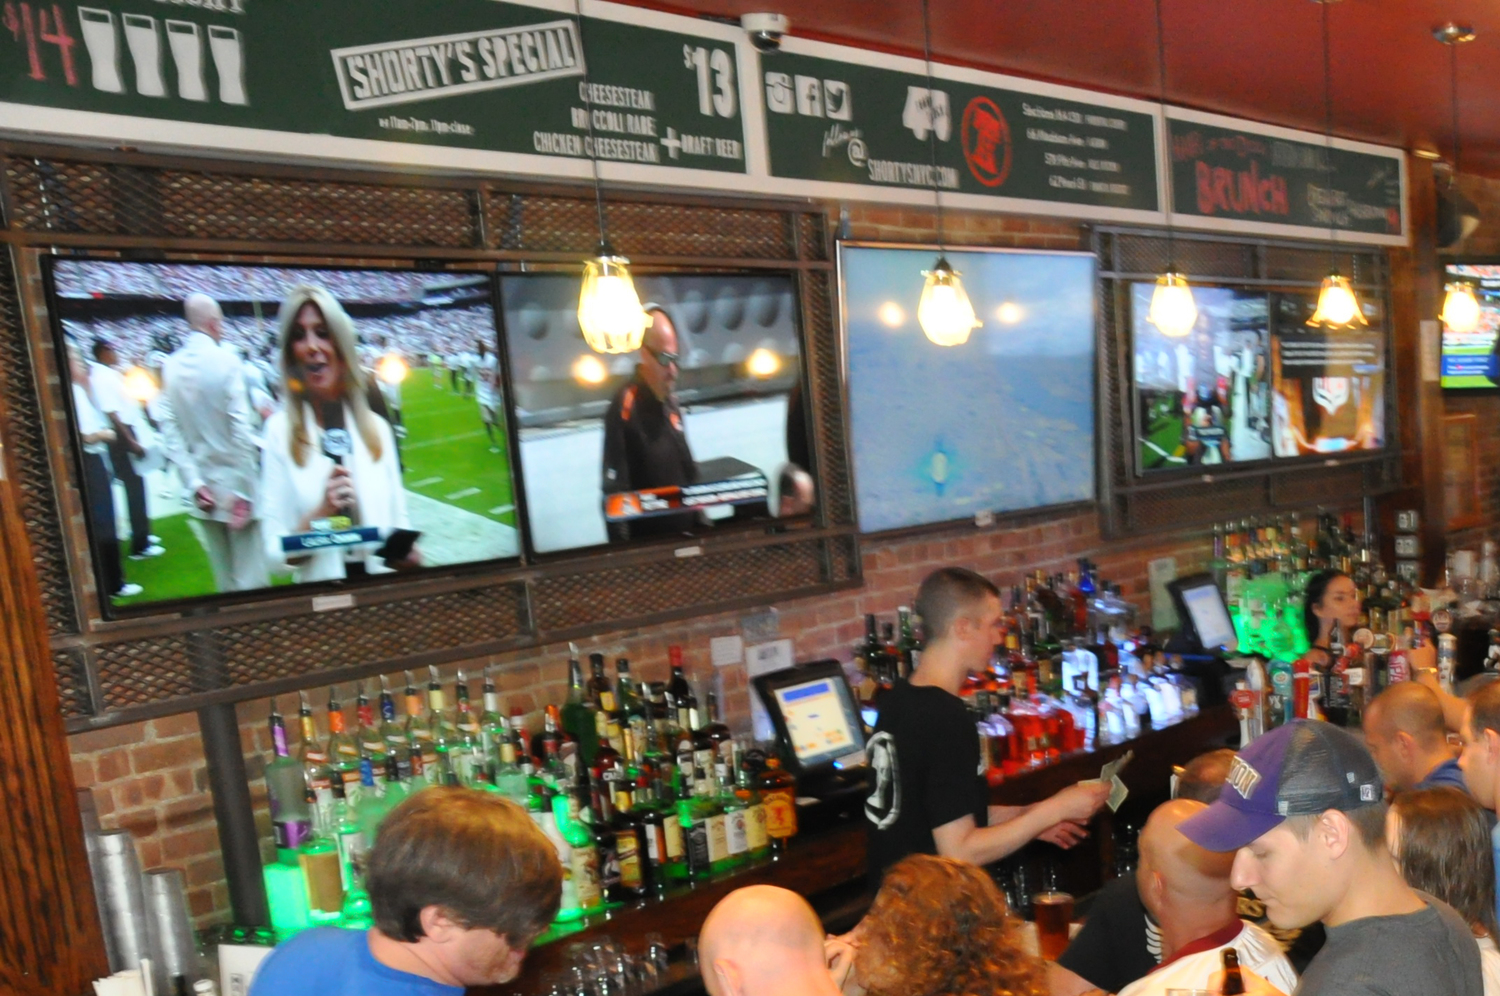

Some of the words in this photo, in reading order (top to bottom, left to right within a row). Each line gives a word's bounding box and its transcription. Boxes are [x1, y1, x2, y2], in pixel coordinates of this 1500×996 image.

[346, 41, 478, 99] SHORTY'S
[478, 28, 576, 79] SPECIAL
[579, 81, 655, 110] CHEESESTEAK
[683, 44, 738, 118] $13
[533, 131, 584, 155] CHICKEN
[584, 136, 661, 163] CHEESESTEAK
[681, 133, 714, 155] DRAFT
